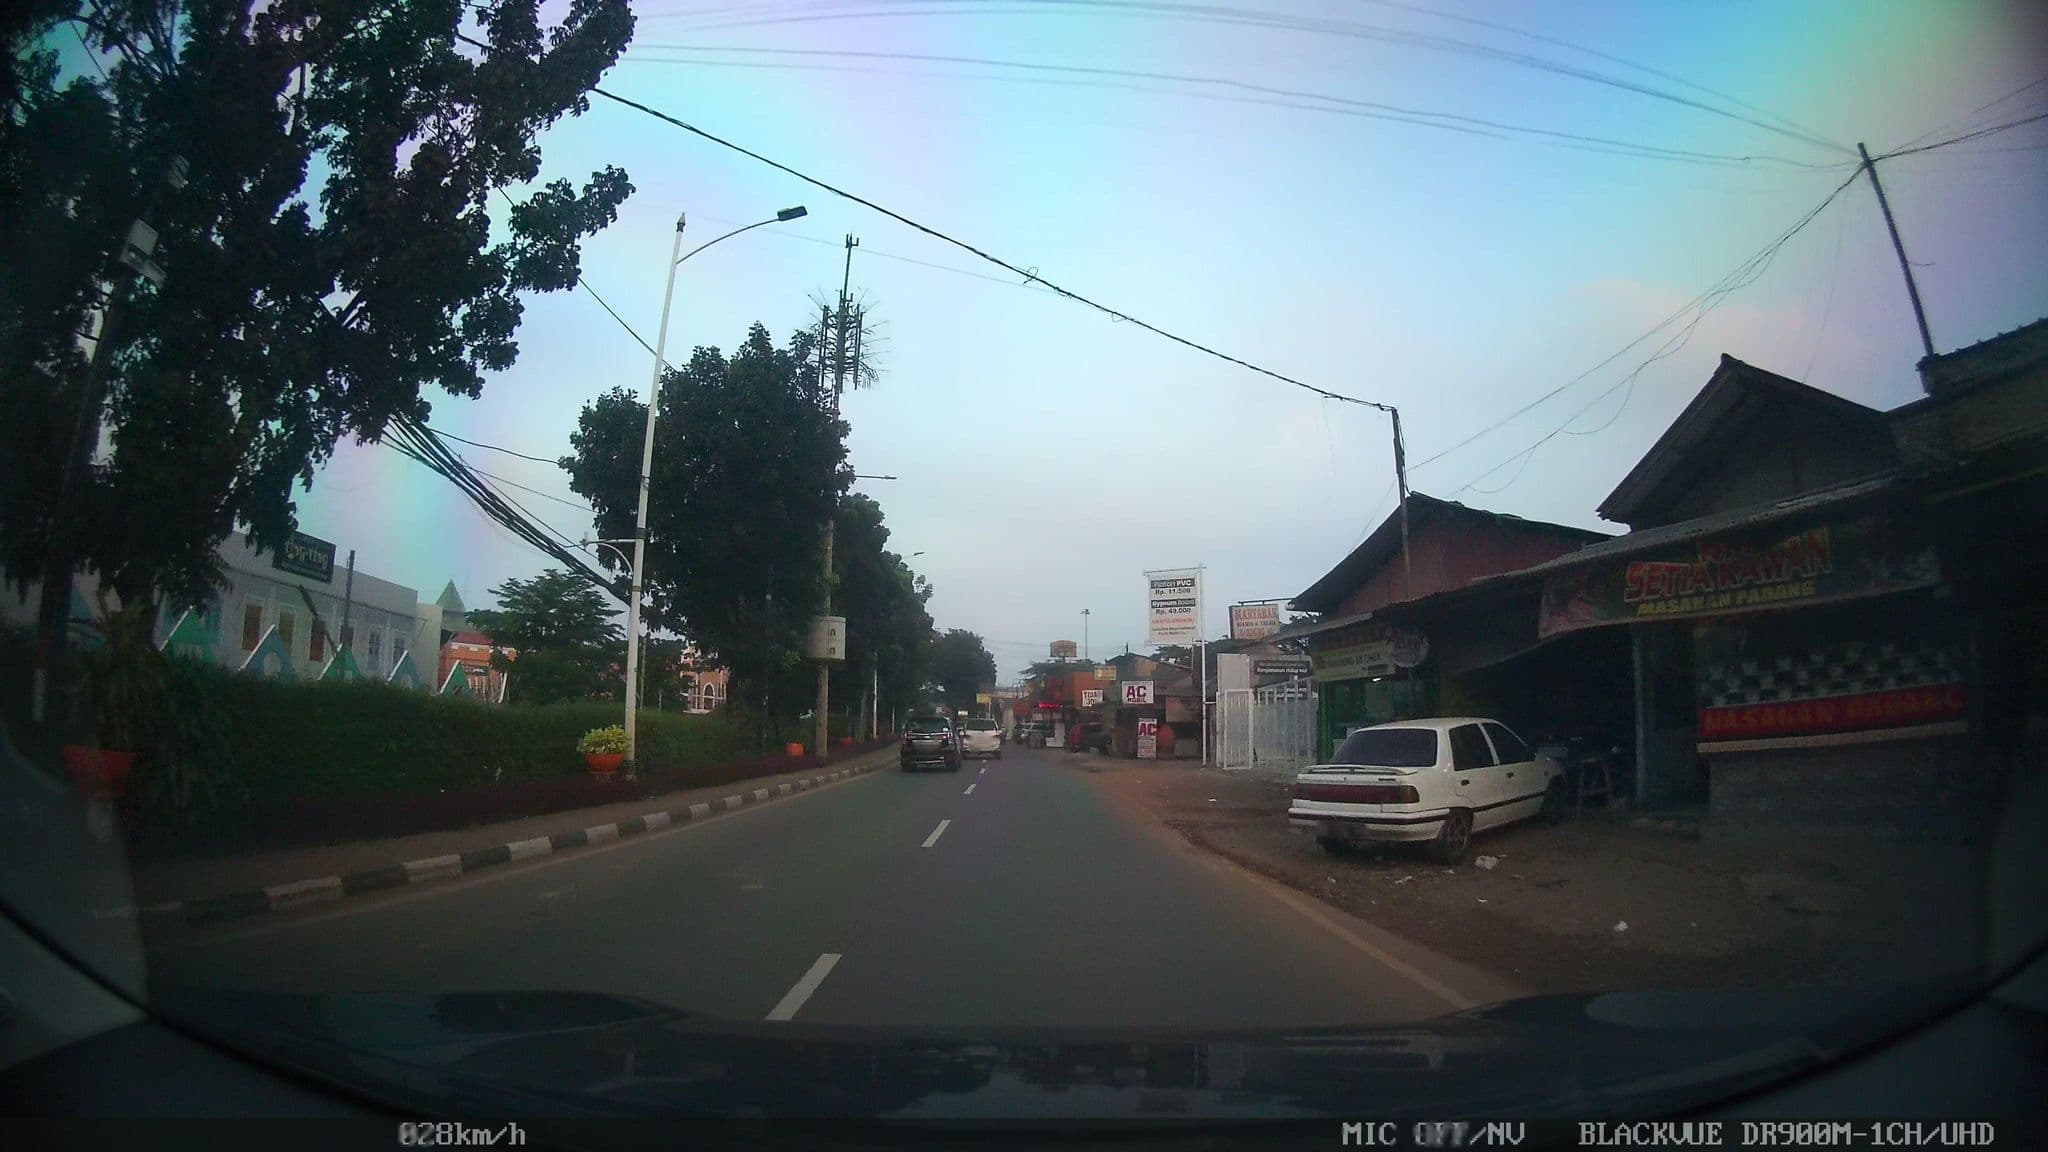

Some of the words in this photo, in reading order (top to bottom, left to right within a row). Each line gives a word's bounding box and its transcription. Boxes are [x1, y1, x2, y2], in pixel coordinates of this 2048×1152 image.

[1176, 578, 1192, 586] PVC
[1623, 557, 1714, 602] SETIA
[1155, 608, 1167, 616] Rp.
[1234, 607, 1277, 619] MARTABAK
[1126, 685, 1147, 698] AC
[1139, 722, 1157, 736] AC
